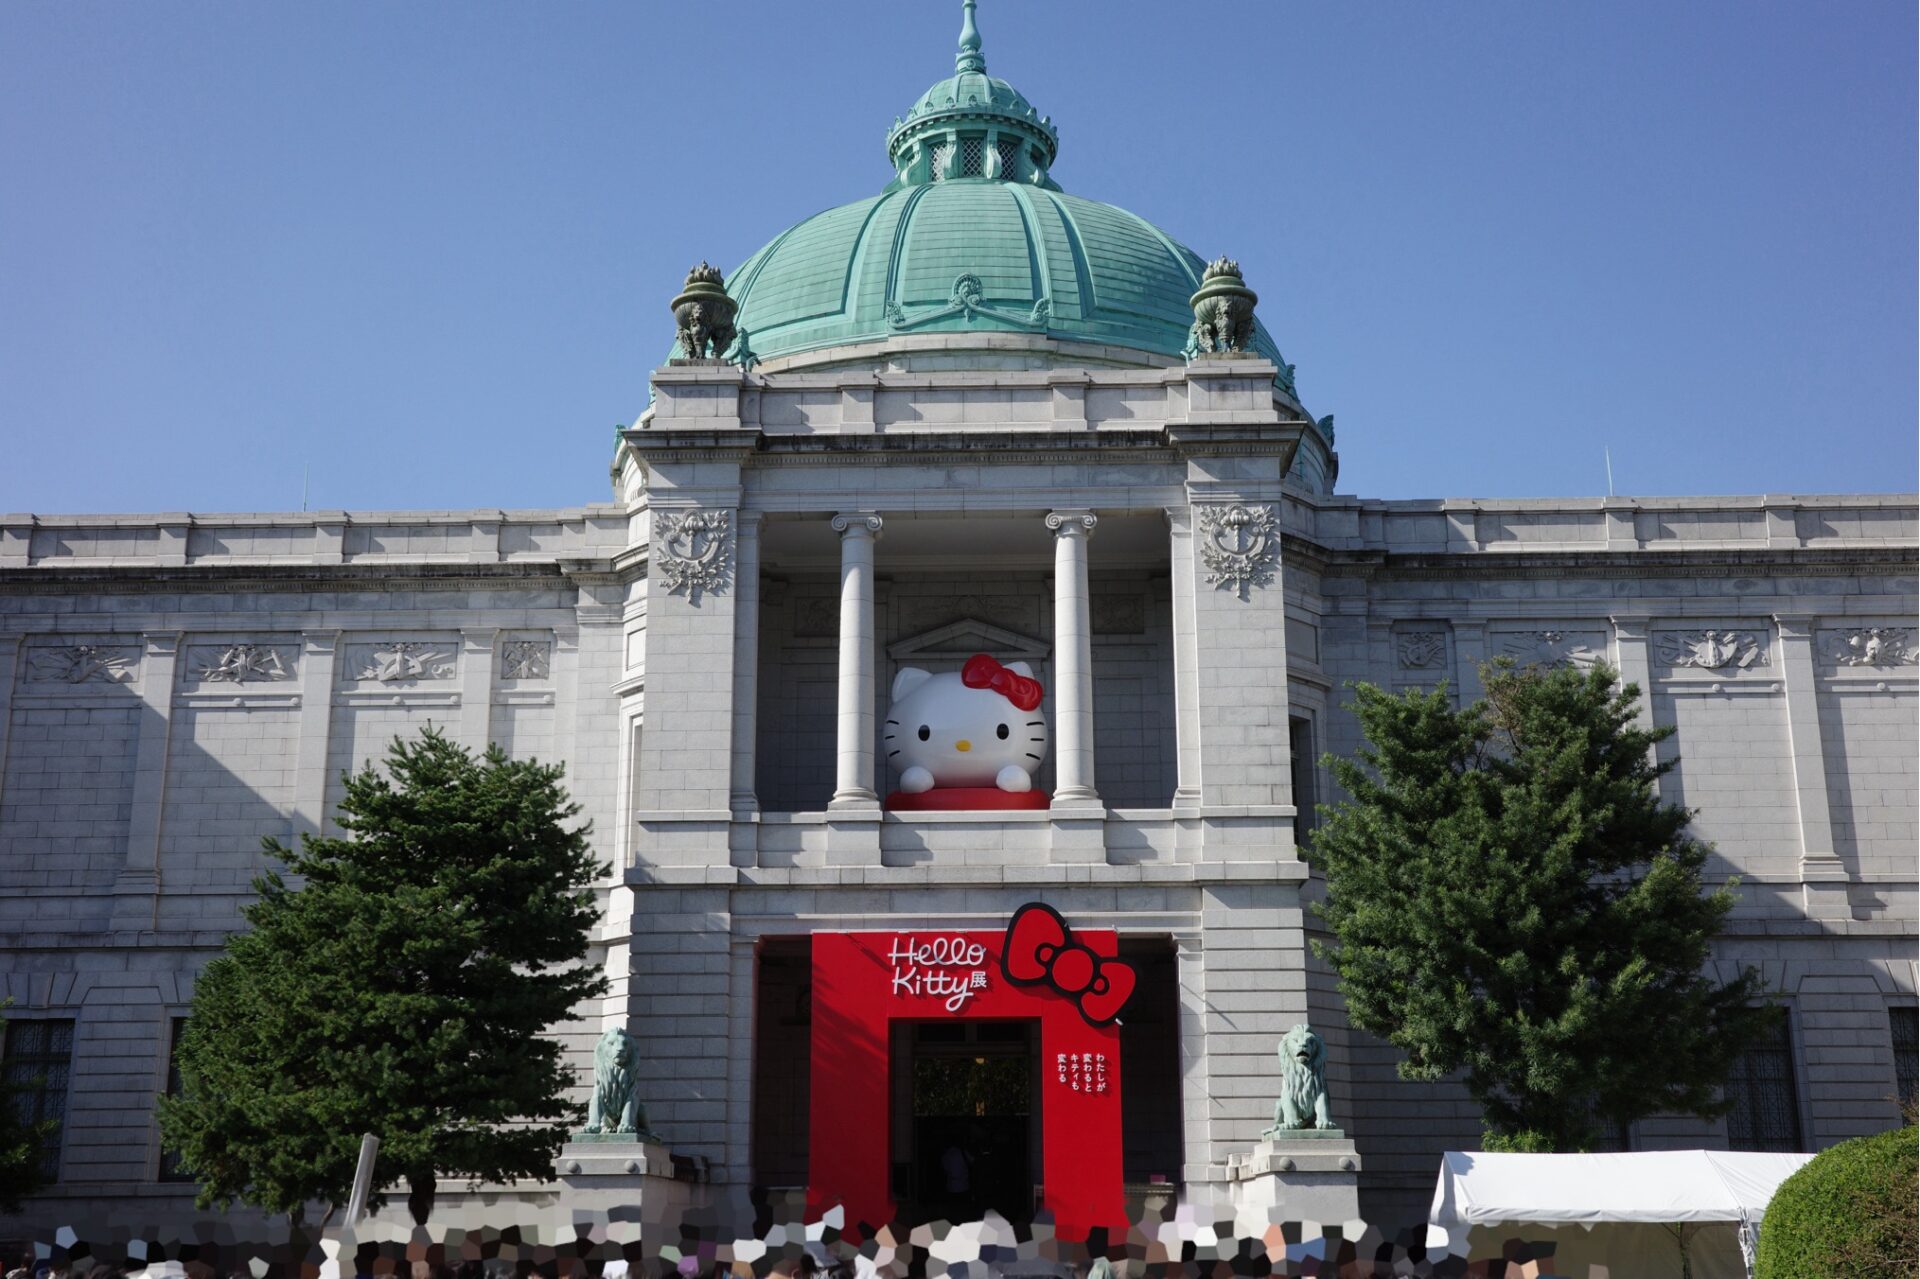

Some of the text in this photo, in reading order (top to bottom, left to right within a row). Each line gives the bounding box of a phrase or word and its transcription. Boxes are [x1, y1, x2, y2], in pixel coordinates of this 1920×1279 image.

[887, 937, 987, 966] Hello
[1057, 1053, 1067, 1083] 変わる
[1070, 1053, 1080, 1091] キティも
[1083, 1053, 1093, 1093] 変わると
[1096, 1053, 1106, 1092] わたしが
